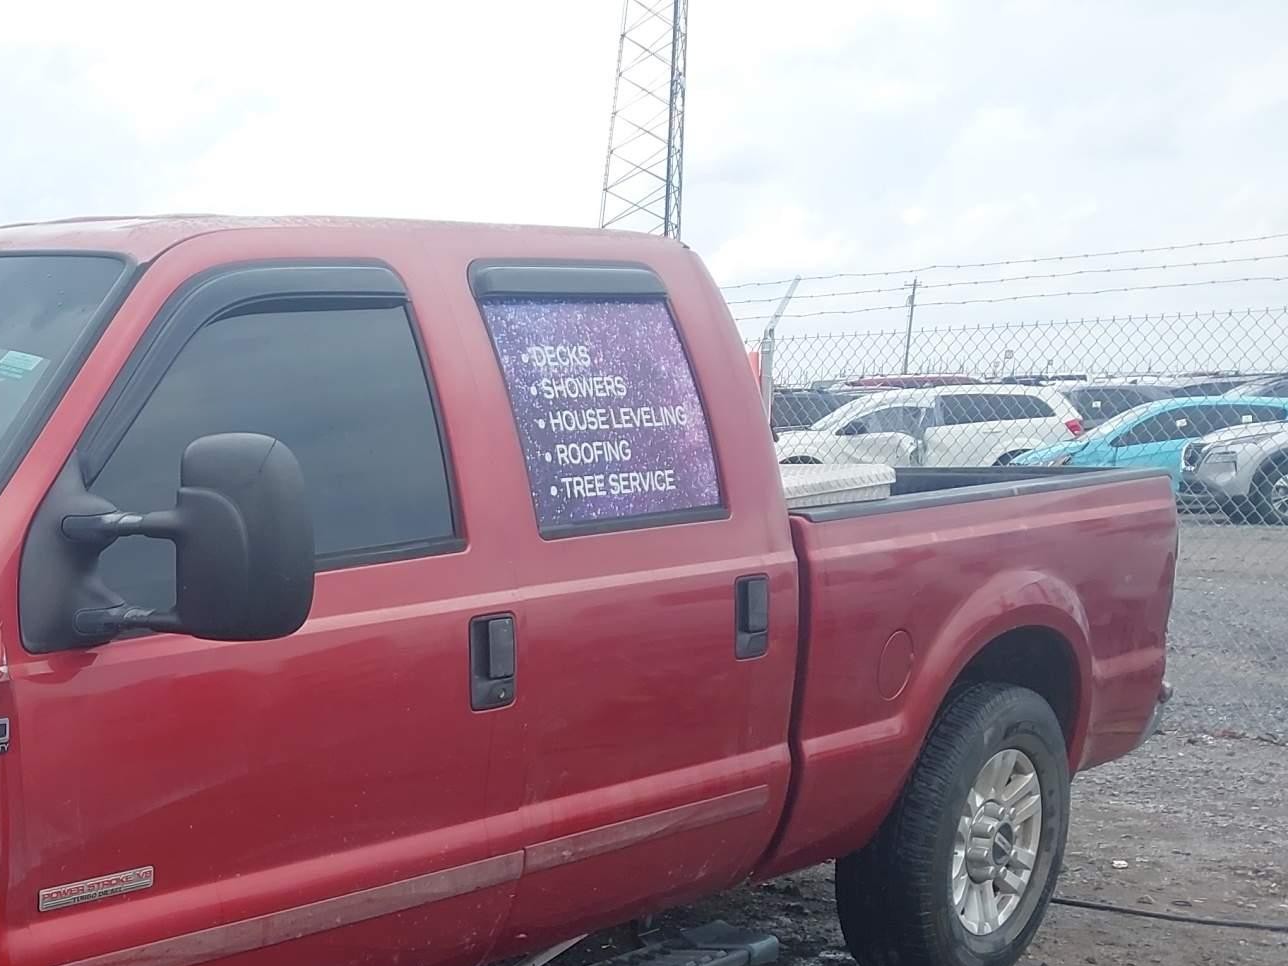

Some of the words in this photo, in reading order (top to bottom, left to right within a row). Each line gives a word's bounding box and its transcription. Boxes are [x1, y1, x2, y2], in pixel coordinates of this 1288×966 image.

[531, 346, 591, 367] DECKS
[542, 376, 627, 399] SHOWERS
[549, 408, 610, 432] HOUSE
[610, 405, 688, 429] LEVELING
[556, 439, 632, 465] ROOFING
[560, 474, 607, 499] TREE
[608, 469, 676, 494] SERVICE
[42, 885, 85, 901] POWER
[87, 874, 133, 892] STROKE
